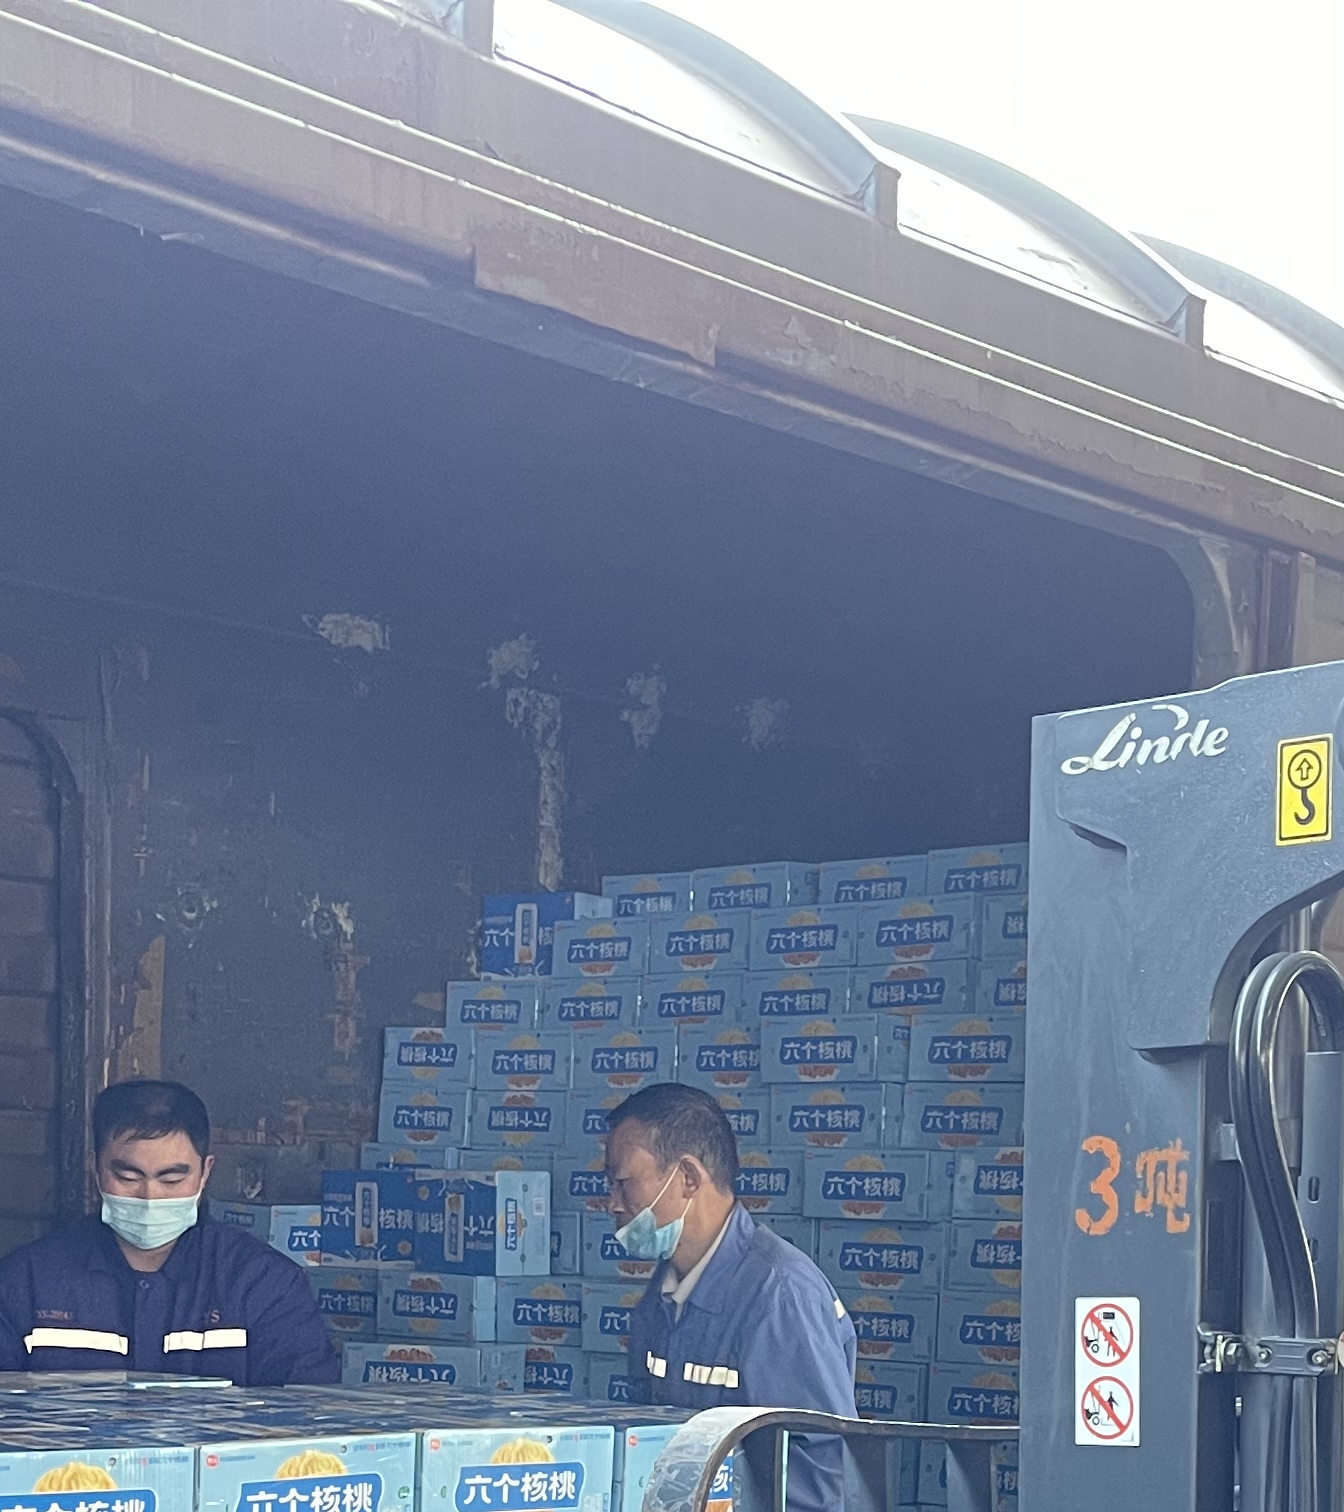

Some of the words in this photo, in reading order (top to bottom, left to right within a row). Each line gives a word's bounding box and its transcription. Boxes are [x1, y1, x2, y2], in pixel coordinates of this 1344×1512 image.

[1060, 704, 1229, 775] Linde
[948, 869, 1019, 890] 六个核桃
[711, 886, 769, 908] 六个核桃
[839, 881, 903, 901] 六个核桃
[770, 929, 834, 950] 六个核桃
[880, 920, 949, 942] 六个核桃
[571, 941, 629, 959] 六个核桃
[670, 932, 731, 952] 六个核桃
[463, 1003, 519, 1021] 六个核桃
[561, 1000, 619, 1018] 六个核桃
[662, 994, 722, 1014] 六个核桃
[764, 992, 827, 1013] 六个核桃
[783, 1039, 853, 1060] 六个核桃
[932, 1039, 1008, 1060] 六个核桃
[495, 1054, 553, 1070] 六个核桃
[595, 1051, 656, 1069] 六个核桃
[396, 1110, 450, 1128] 六个核桃
[793, 1109, 861, 1129] 六个核桃
[926, 1110, 999, 1131] 六个核桃
[572, 1175, 610, 1193] 六个
[736, 1172, 786, 1192] 个核桃
[827, 1176, 902, 1196] 六个核桃
[979, 1169, 1023, 1189] 核桃
[292, 1230, 321, 1248] 六个
[844, 1247, 919, 1270] 六个核桃
[976, 1244, 1022, 1264] 核桃
[517, 1304, 579, 1323] 六个核桃
[856, 1317, 910, 1342] 个核桃
[966, 1322, 1021, 1342] 六个核
[525, 1365, 569, 1385] 六个核
[856, 1390, 892, 1410] 核桃
[952, 1392, 1020, 1415] 六个核
[464, 1471, 577, 1504] 六个核桃
